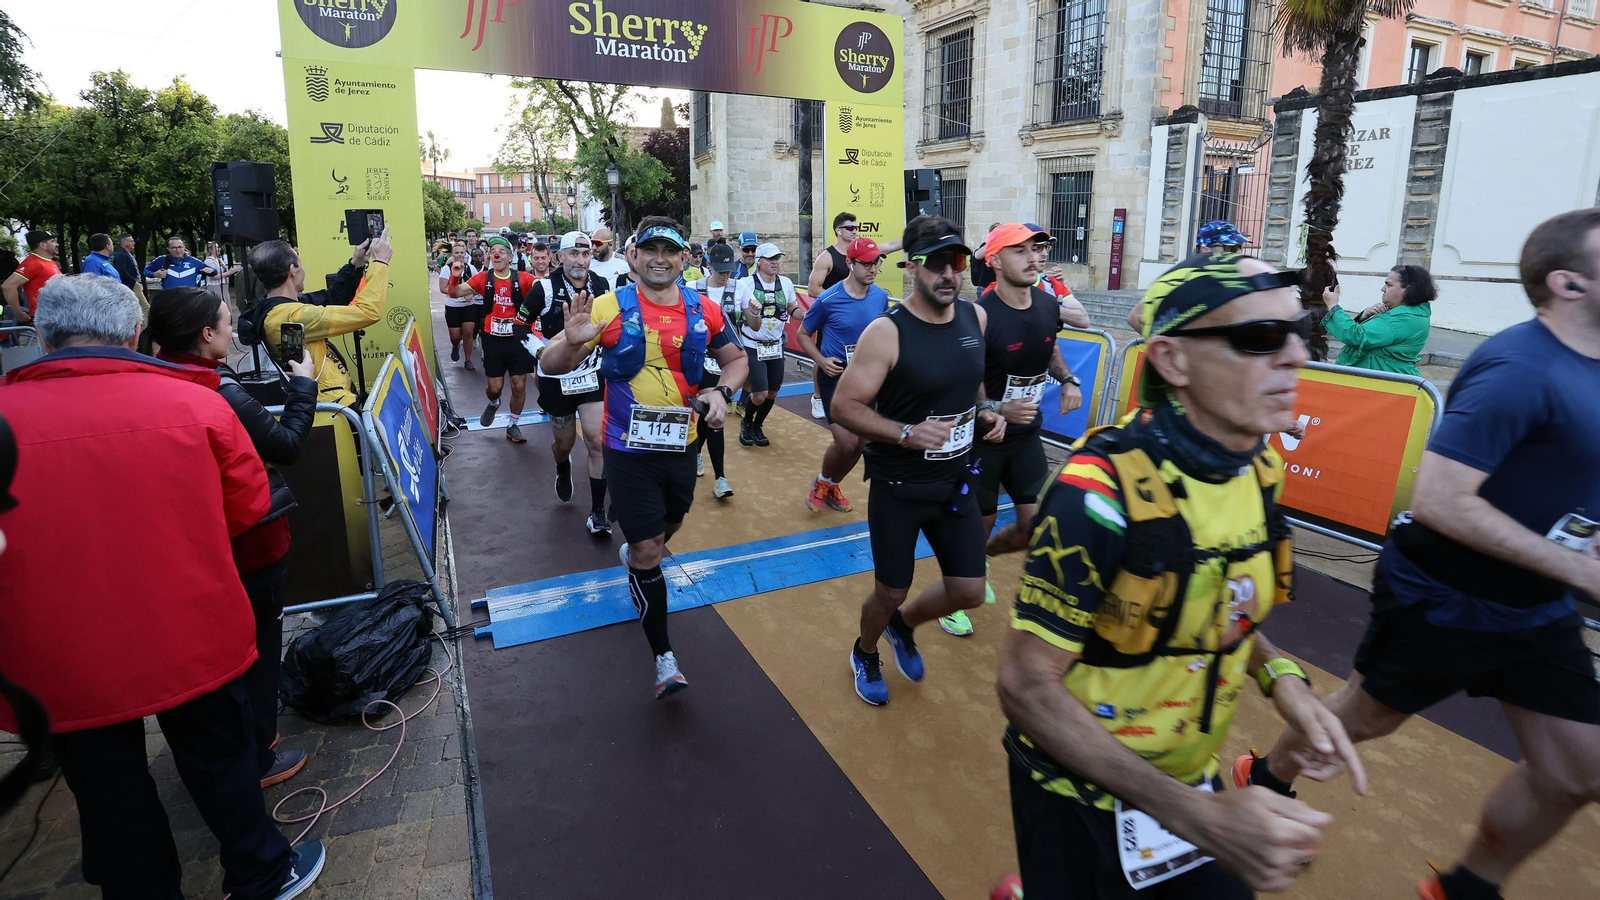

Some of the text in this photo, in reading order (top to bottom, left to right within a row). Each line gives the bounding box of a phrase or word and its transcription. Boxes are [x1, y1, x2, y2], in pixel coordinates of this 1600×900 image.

[319, 7, 376, 21] Maratón
[568, 0, 708, 60] Sherry
[595, 37, 688, 63] Maratón
[744, 13, 793, 77] JJP
[840, 48, 889, 72] Sherry
[848, 62, 882, 73] Maratón
[334, 78, 396, 89] Ayuntamiento
[347, 87, 370, 96] Jerez
[855, 115, 893, 124] Ayuntamiento
[348, 123, 399, 135] Diputación
[1346, 127, 1391, 142] AZAR
[349, 136, 391, 147] de Cádiz
[861, 148, 893, 158] Diputación
[870, 158, 887, 167] Cádiz
[1344, 157, 1374, 171] REZ
[389, 307, 412, 322] VALDESPIN
[352, 352, 394, 360] CVIJERE
[1020, 385, 1038, 398] 143
[648, 422, 671, 437] 114
[953, 426, 966, 442] 66
[1283, 462, 1321, 479] ION!
